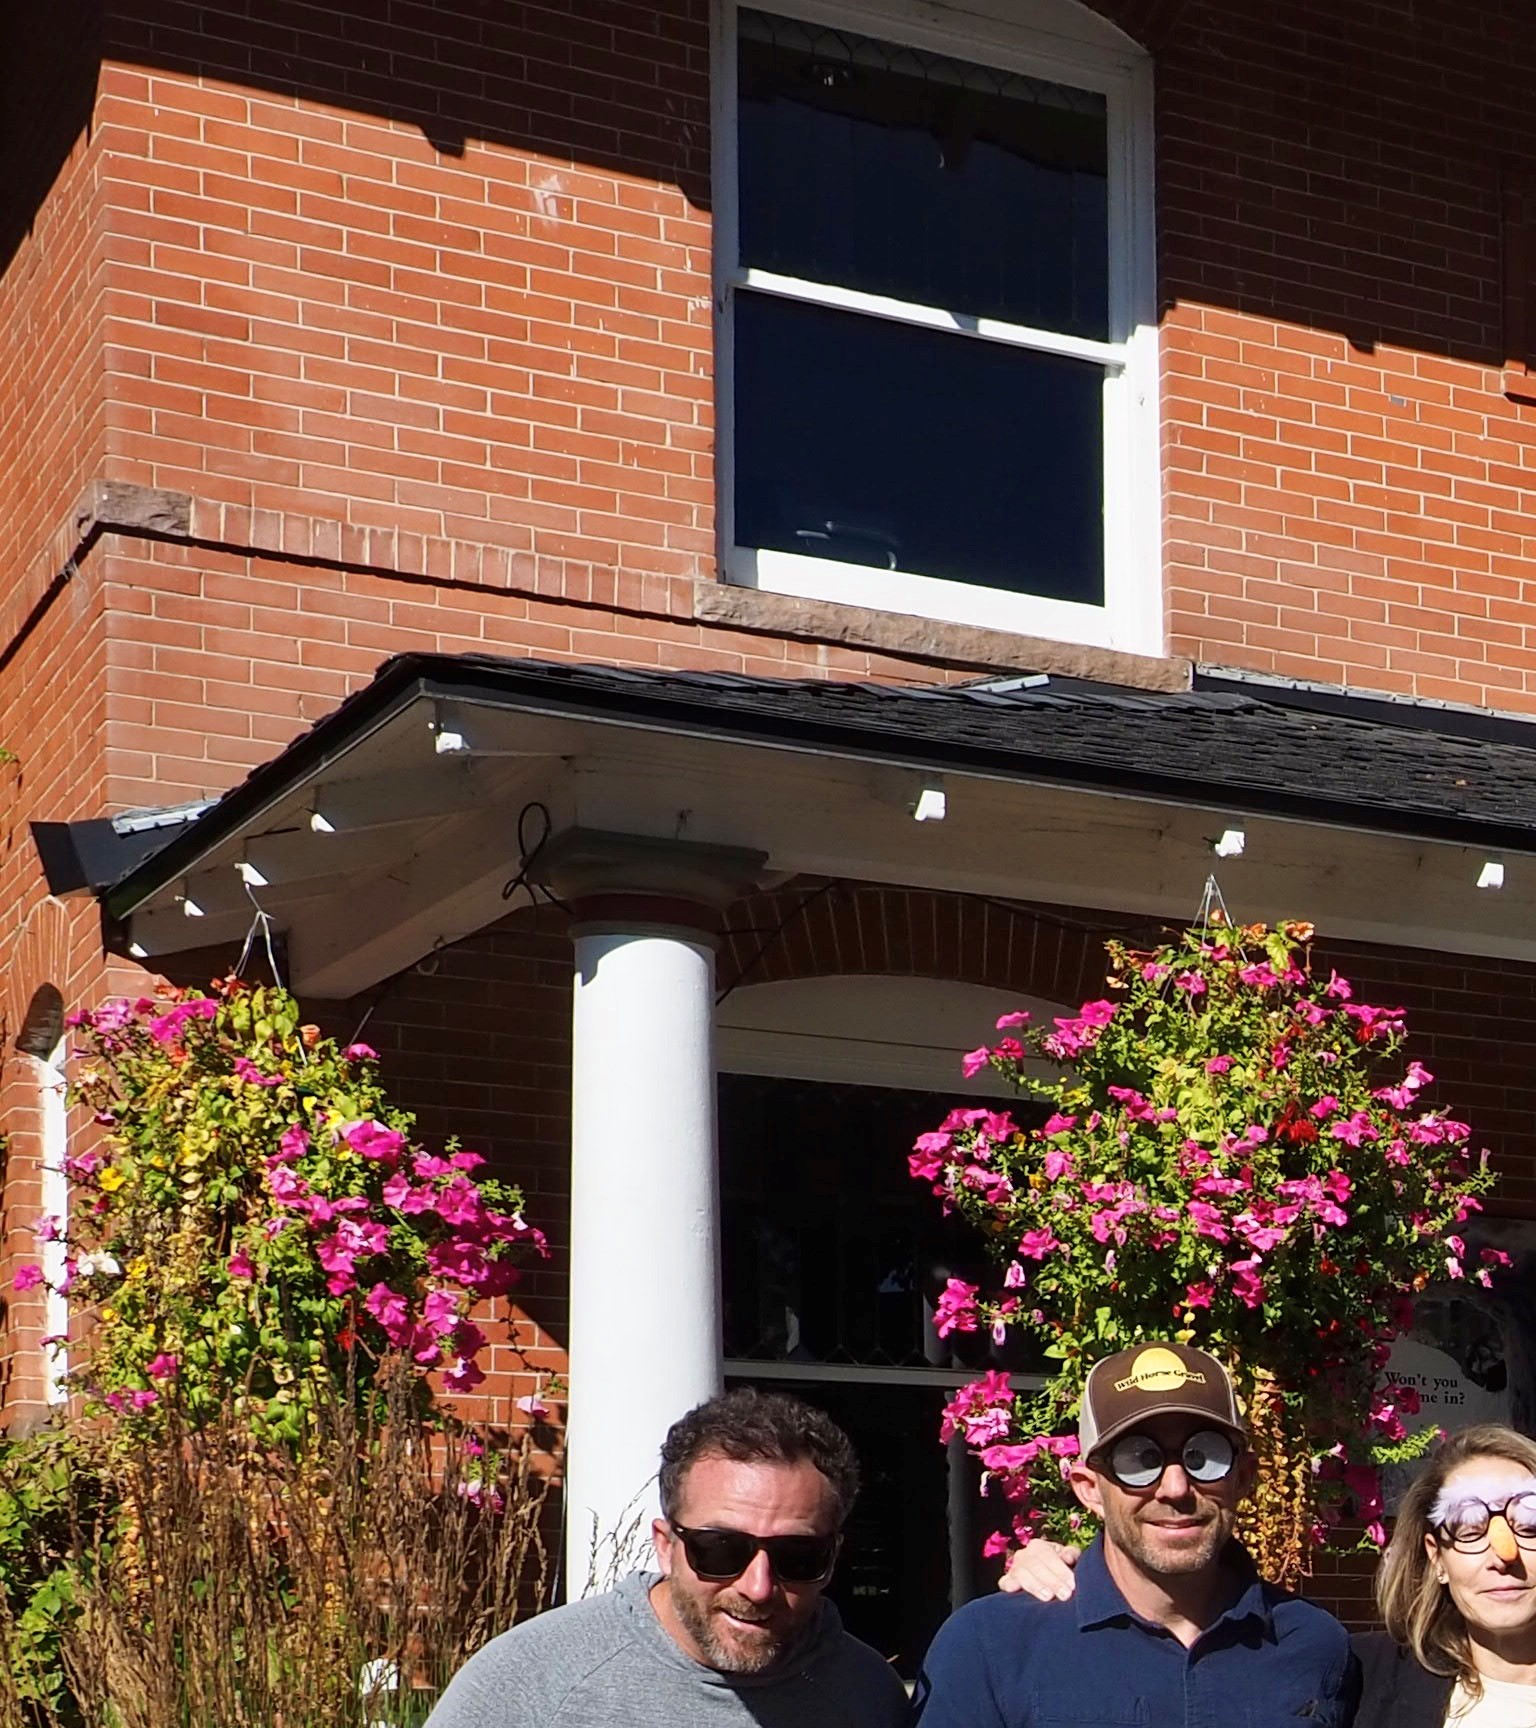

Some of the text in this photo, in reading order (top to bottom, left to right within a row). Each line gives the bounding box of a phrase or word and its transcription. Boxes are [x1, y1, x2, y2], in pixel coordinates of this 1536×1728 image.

[1385, 1372, 1458, 1391] Won't you
[1444, 1391, 1465, 1405] in?
